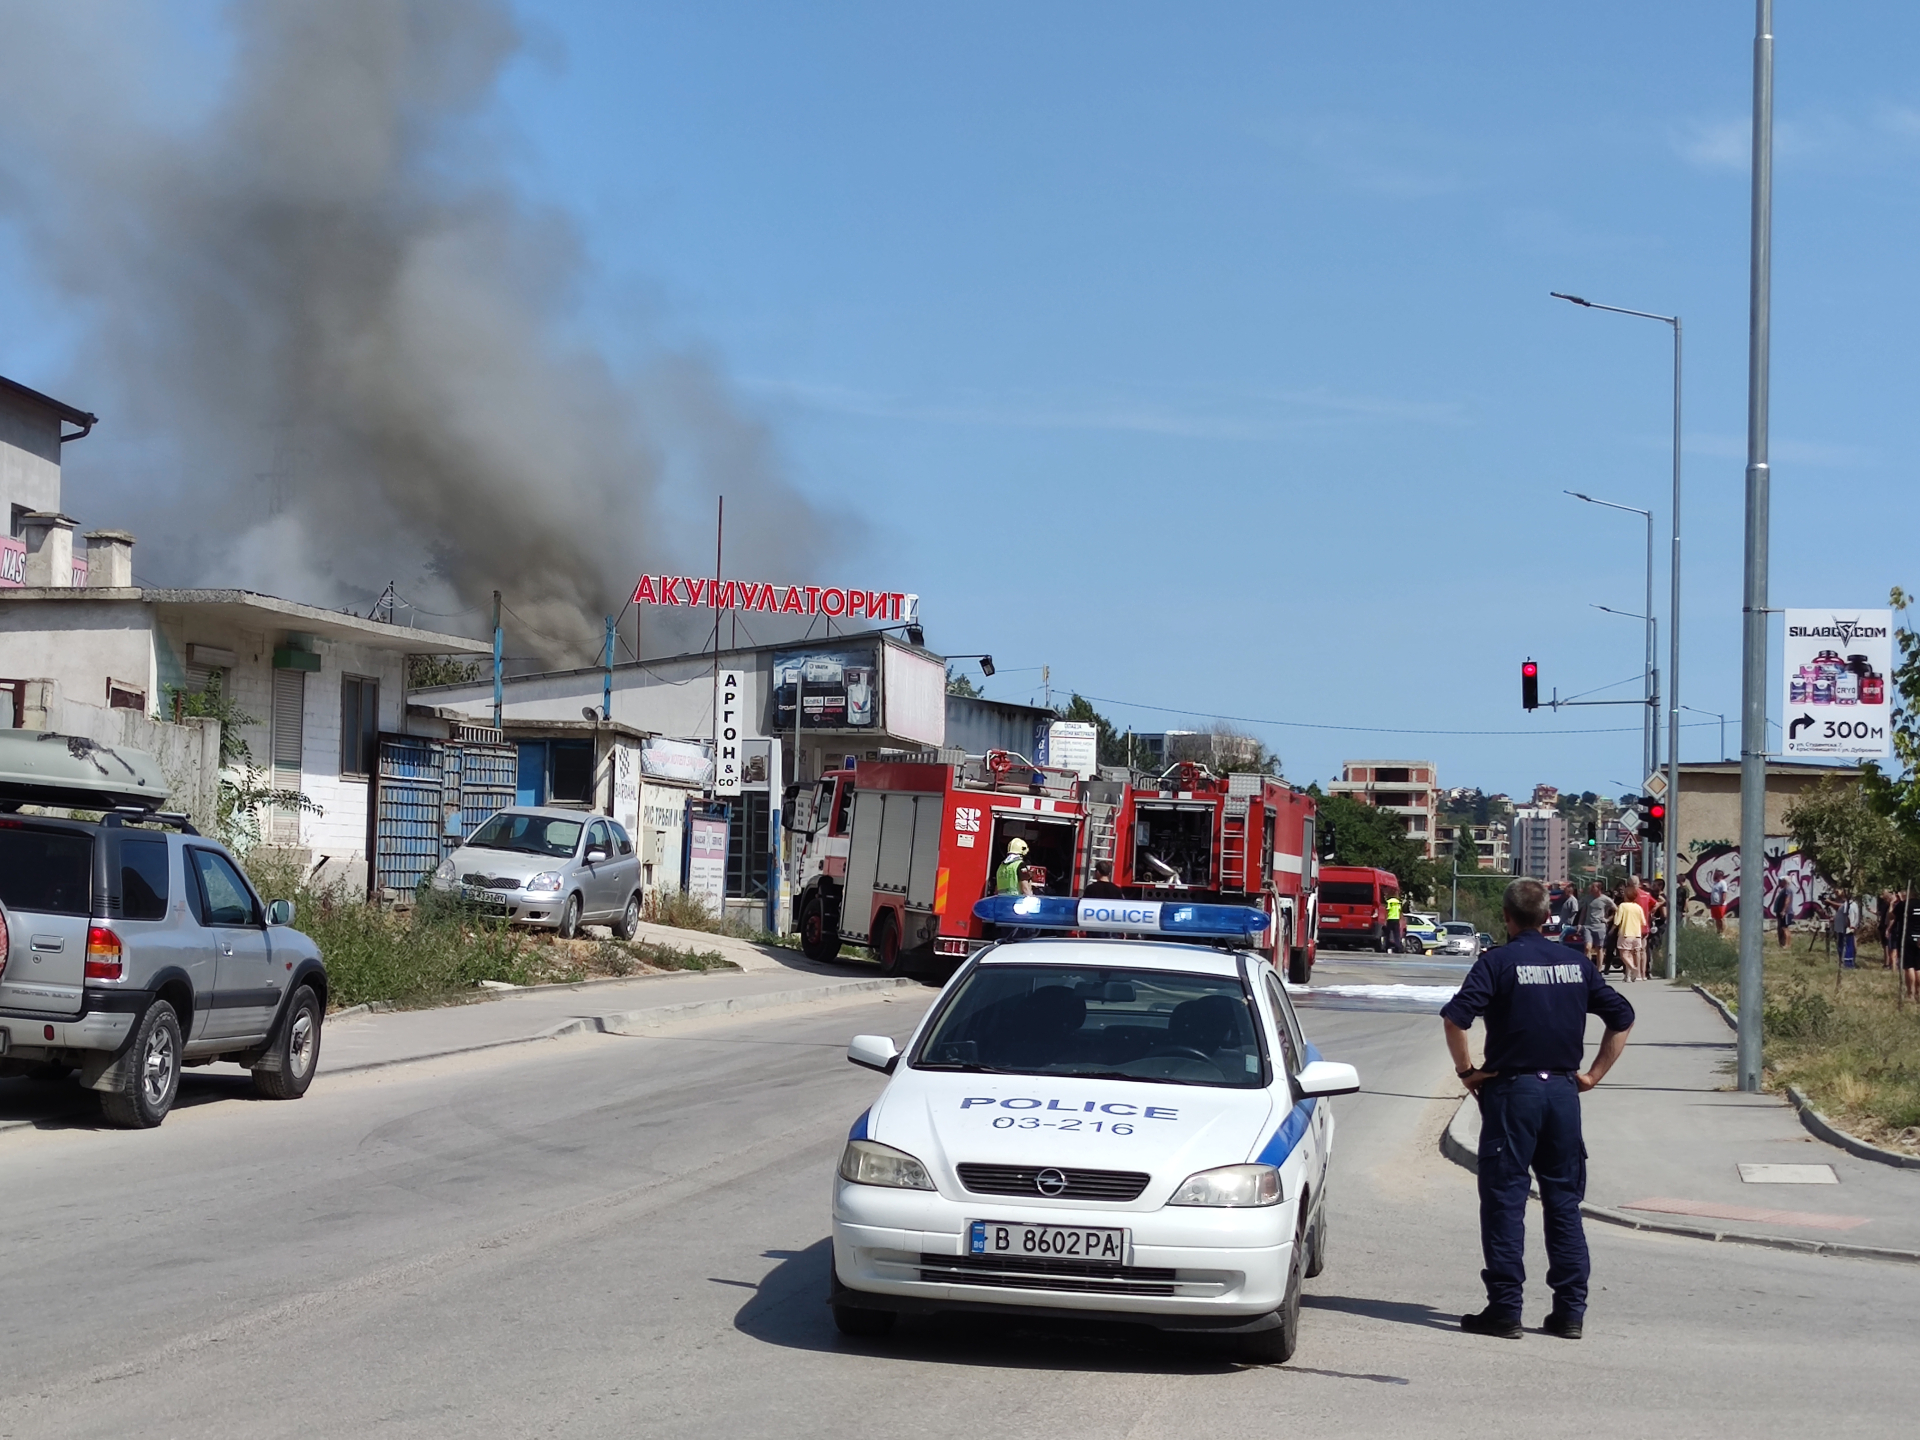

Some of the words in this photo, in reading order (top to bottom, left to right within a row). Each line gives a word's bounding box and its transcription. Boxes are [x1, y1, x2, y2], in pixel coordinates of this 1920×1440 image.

[722, 674, 737, 760] АРГОН
[724, 764, 734, 774] &
[1083, 908, 1154, 923] POLICE
[1554, 964, 1583, 984] POLICE
[960, 1097, 1179, 1120] POLICE
[992, 1116, 1134, 1136] 03-216
[995, 1227, 1010, 1251] B
